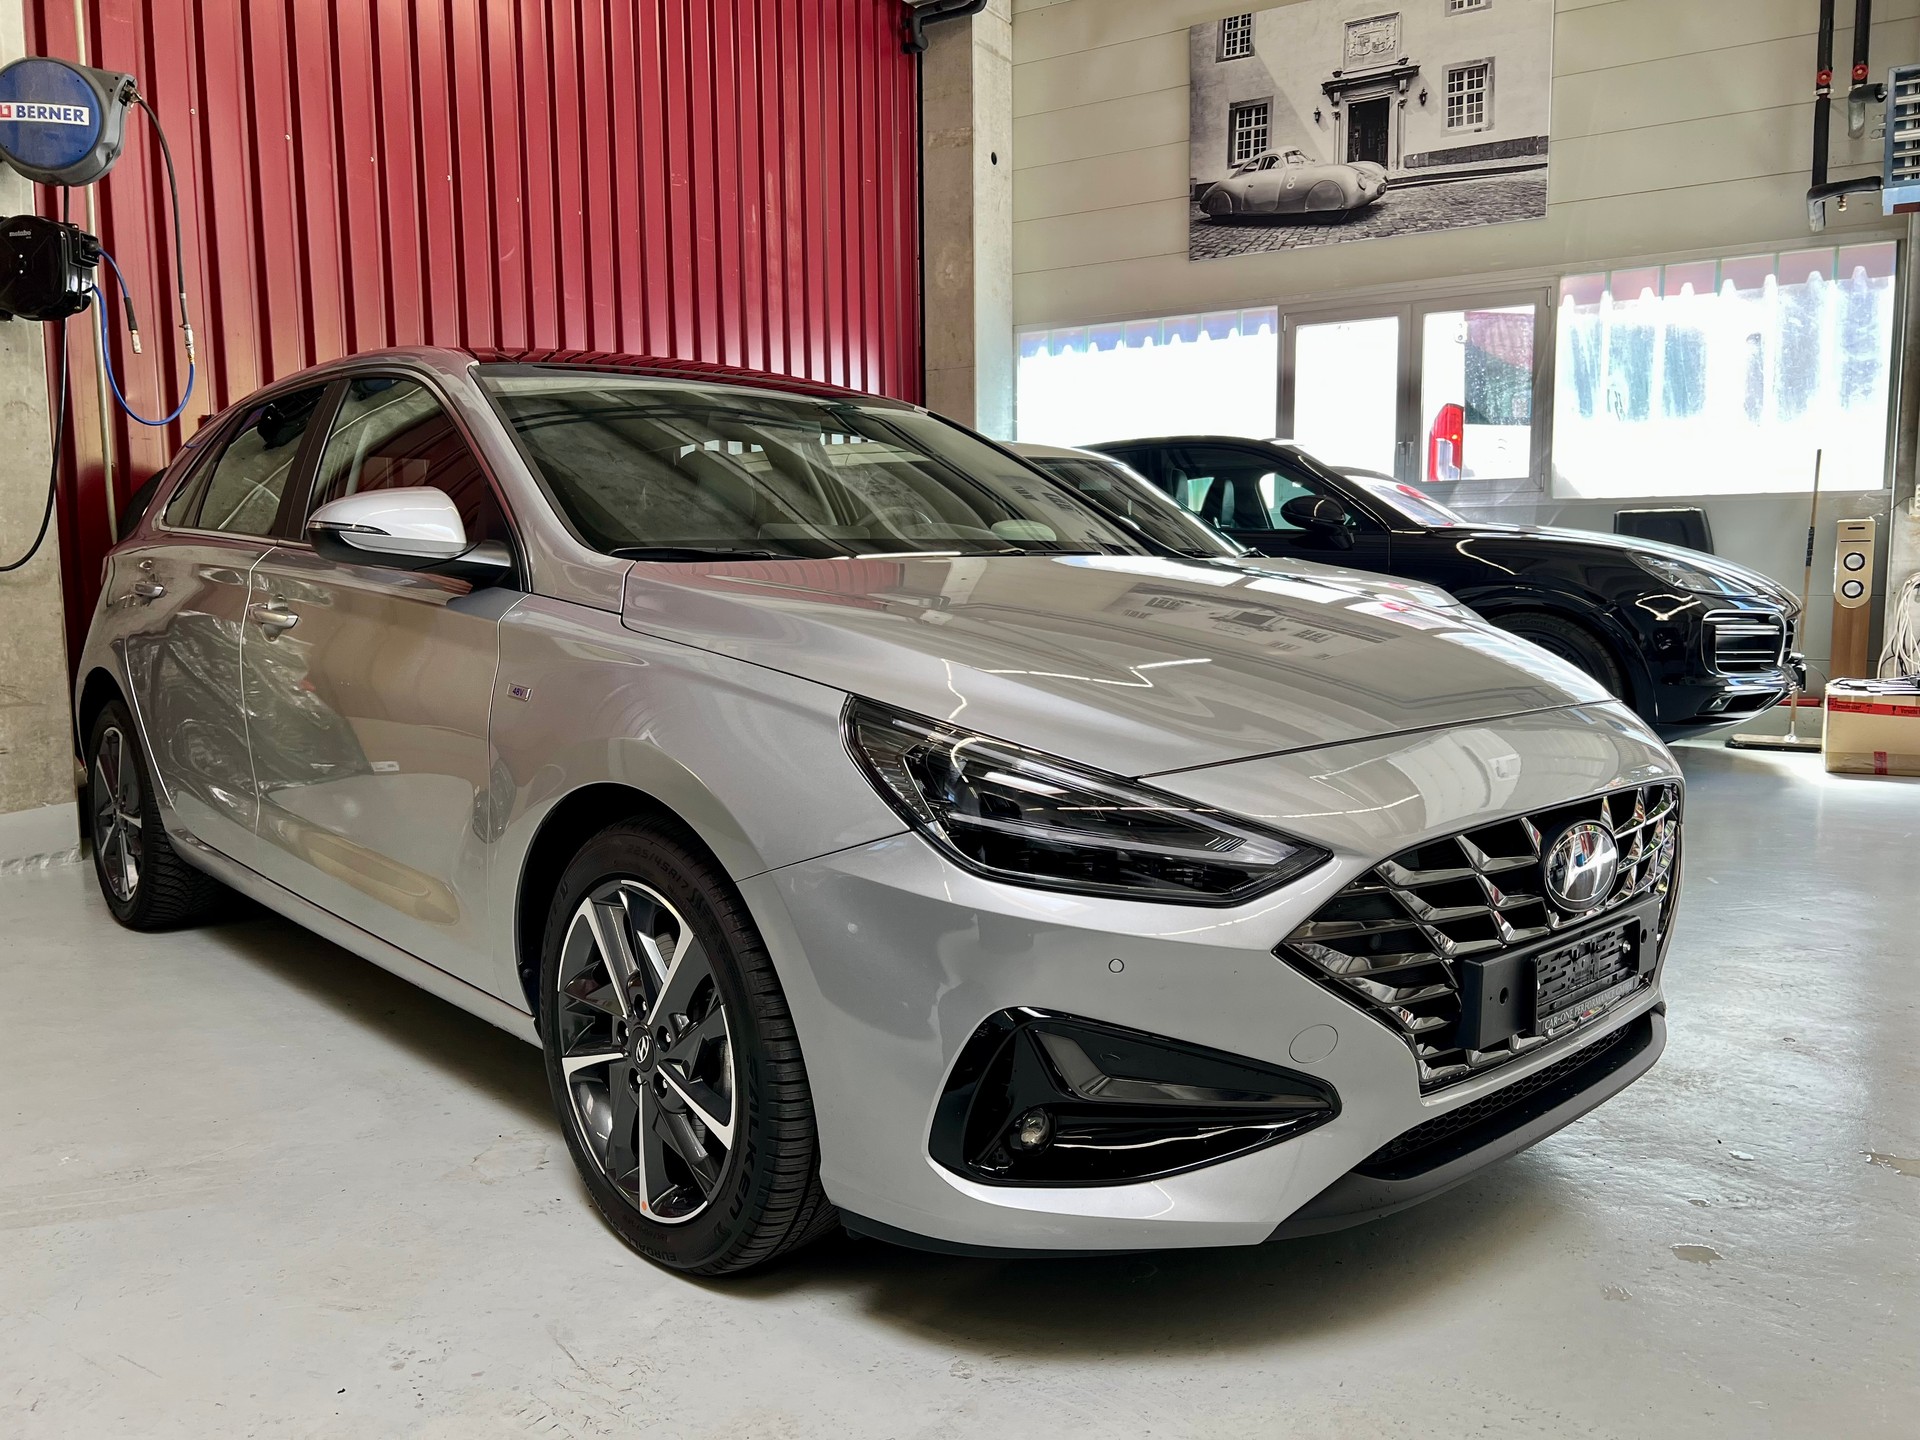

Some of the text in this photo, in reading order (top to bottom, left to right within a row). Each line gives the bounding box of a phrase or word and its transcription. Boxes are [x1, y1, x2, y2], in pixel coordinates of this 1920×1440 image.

[16, 105, 85, 122] BERNER
[1286, 175, 1297, 190] 8
[1545, 1008, 1574, 1029] CAR-ONE
[1574, 989, 1616, 1016] PERFORMANCE
